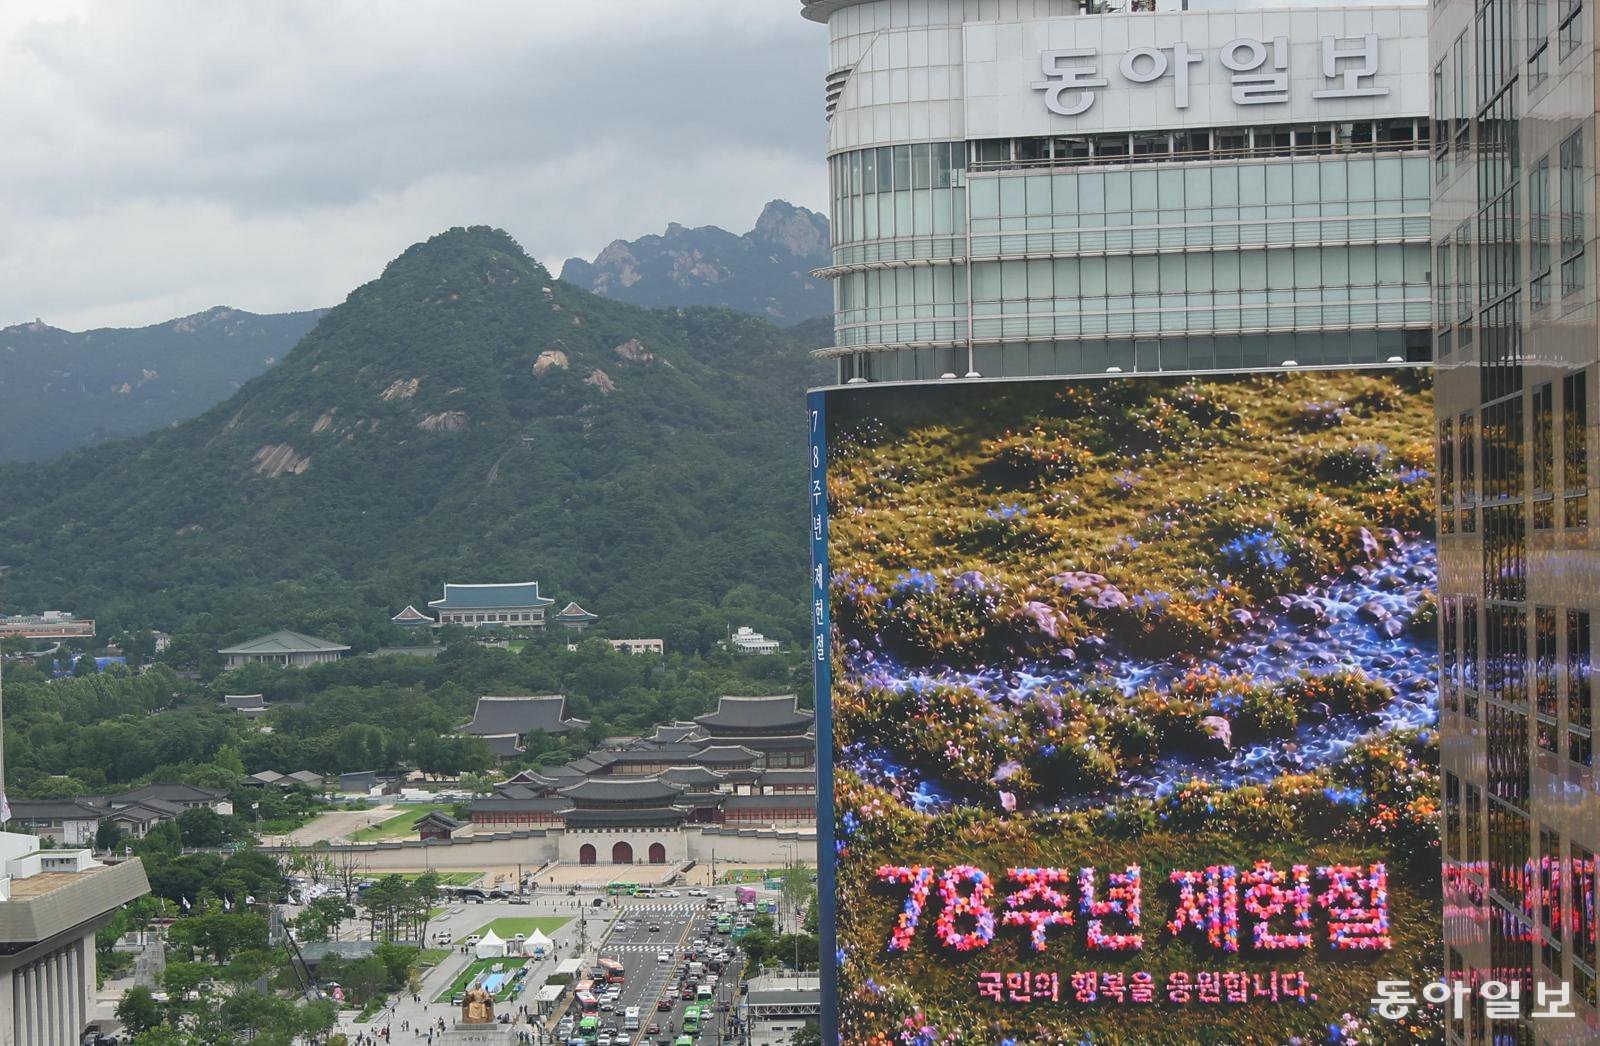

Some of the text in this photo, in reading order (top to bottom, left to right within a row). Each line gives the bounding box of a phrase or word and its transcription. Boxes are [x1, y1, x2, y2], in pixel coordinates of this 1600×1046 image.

[1030, 33, 1390, 116] 동아일보
[811, 410, 825, 661] 78주년 제헌절
[875, 862, 1145, 952] 78주년
[1166, 859, 1392, 952] 제헌절
[977, 971, 1318, 1004] 국민의 행복을 응원합니다.
